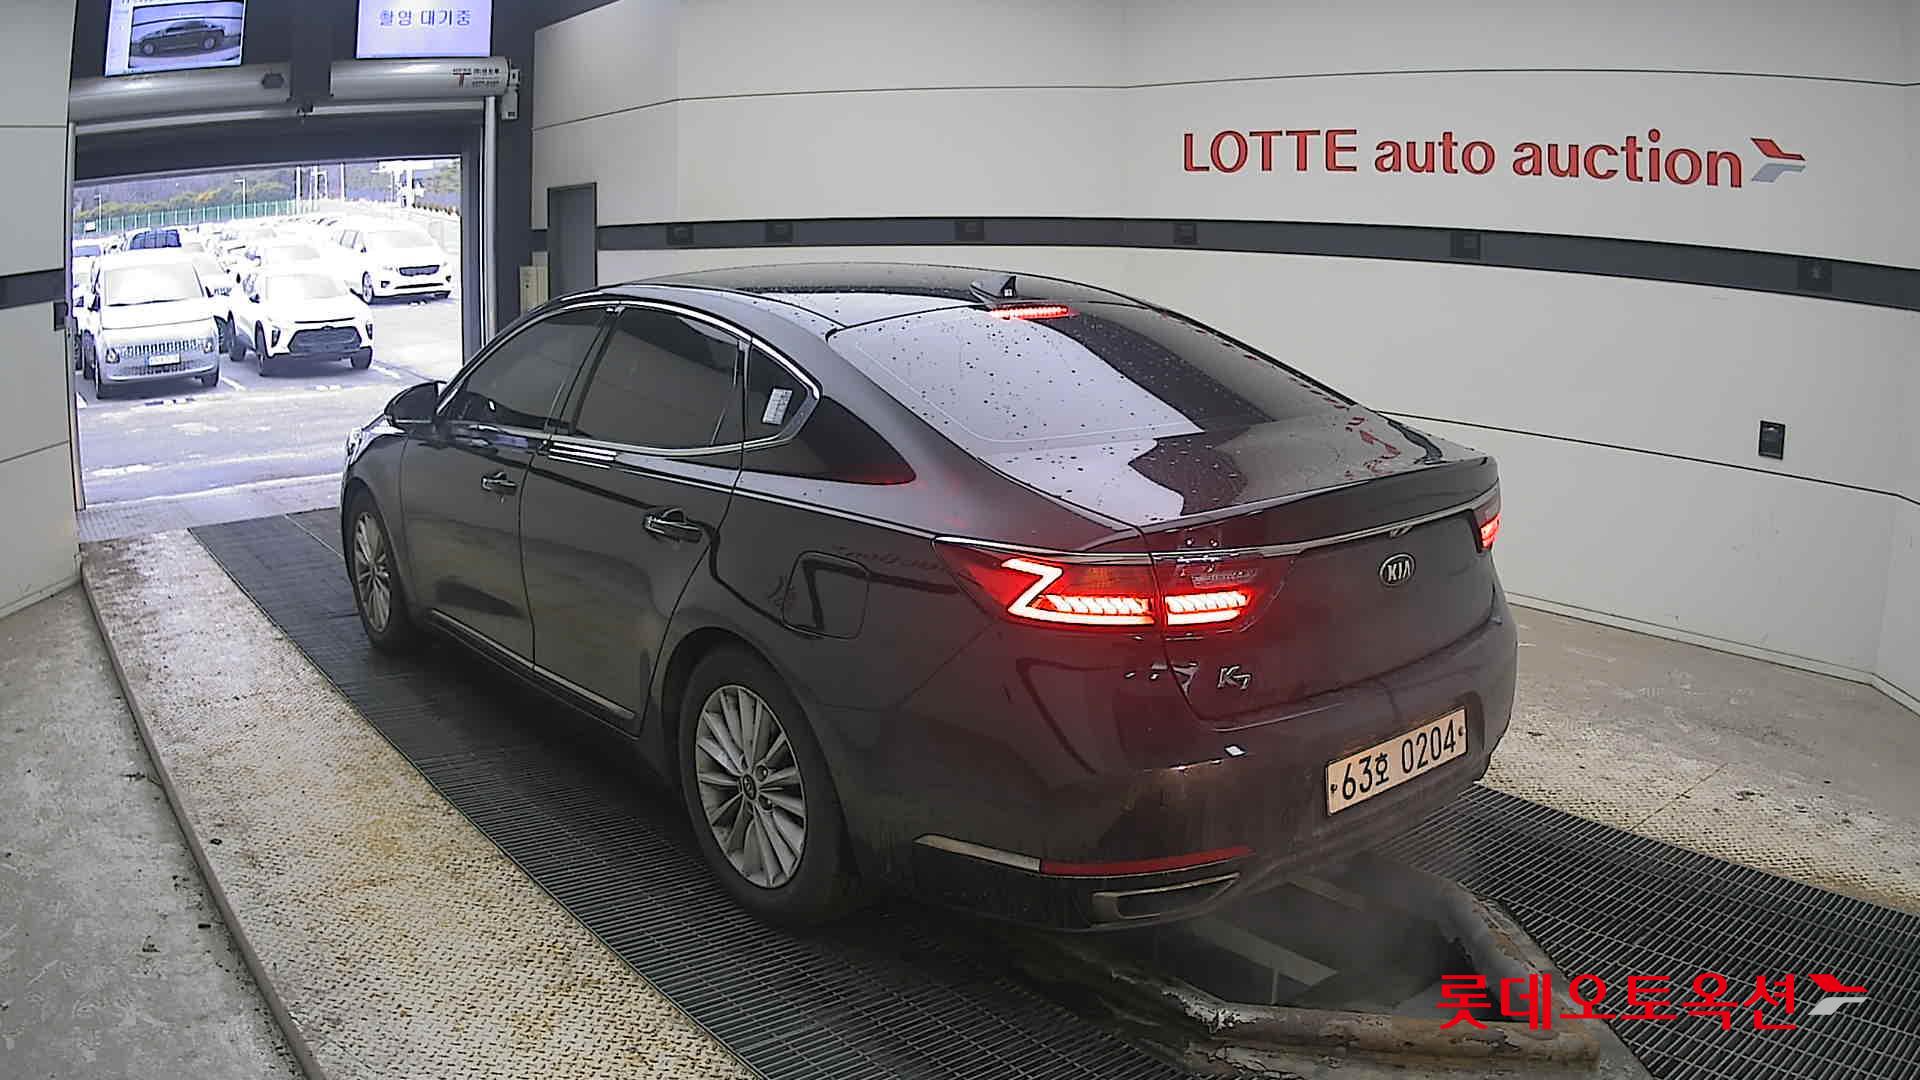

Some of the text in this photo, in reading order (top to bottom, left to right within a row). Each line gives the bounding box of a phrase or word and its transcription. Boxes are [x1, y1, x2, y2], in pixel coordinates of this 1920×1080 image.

[420, 10, 472, 26] 대기중
[1183, 128, 1744, 188] LOTTE auto auction
[1387, 560, 1412, 582] KIA
[1217, 665, 1252, 690] K7
[1342, 719, 1457, 801] 63호 0204
